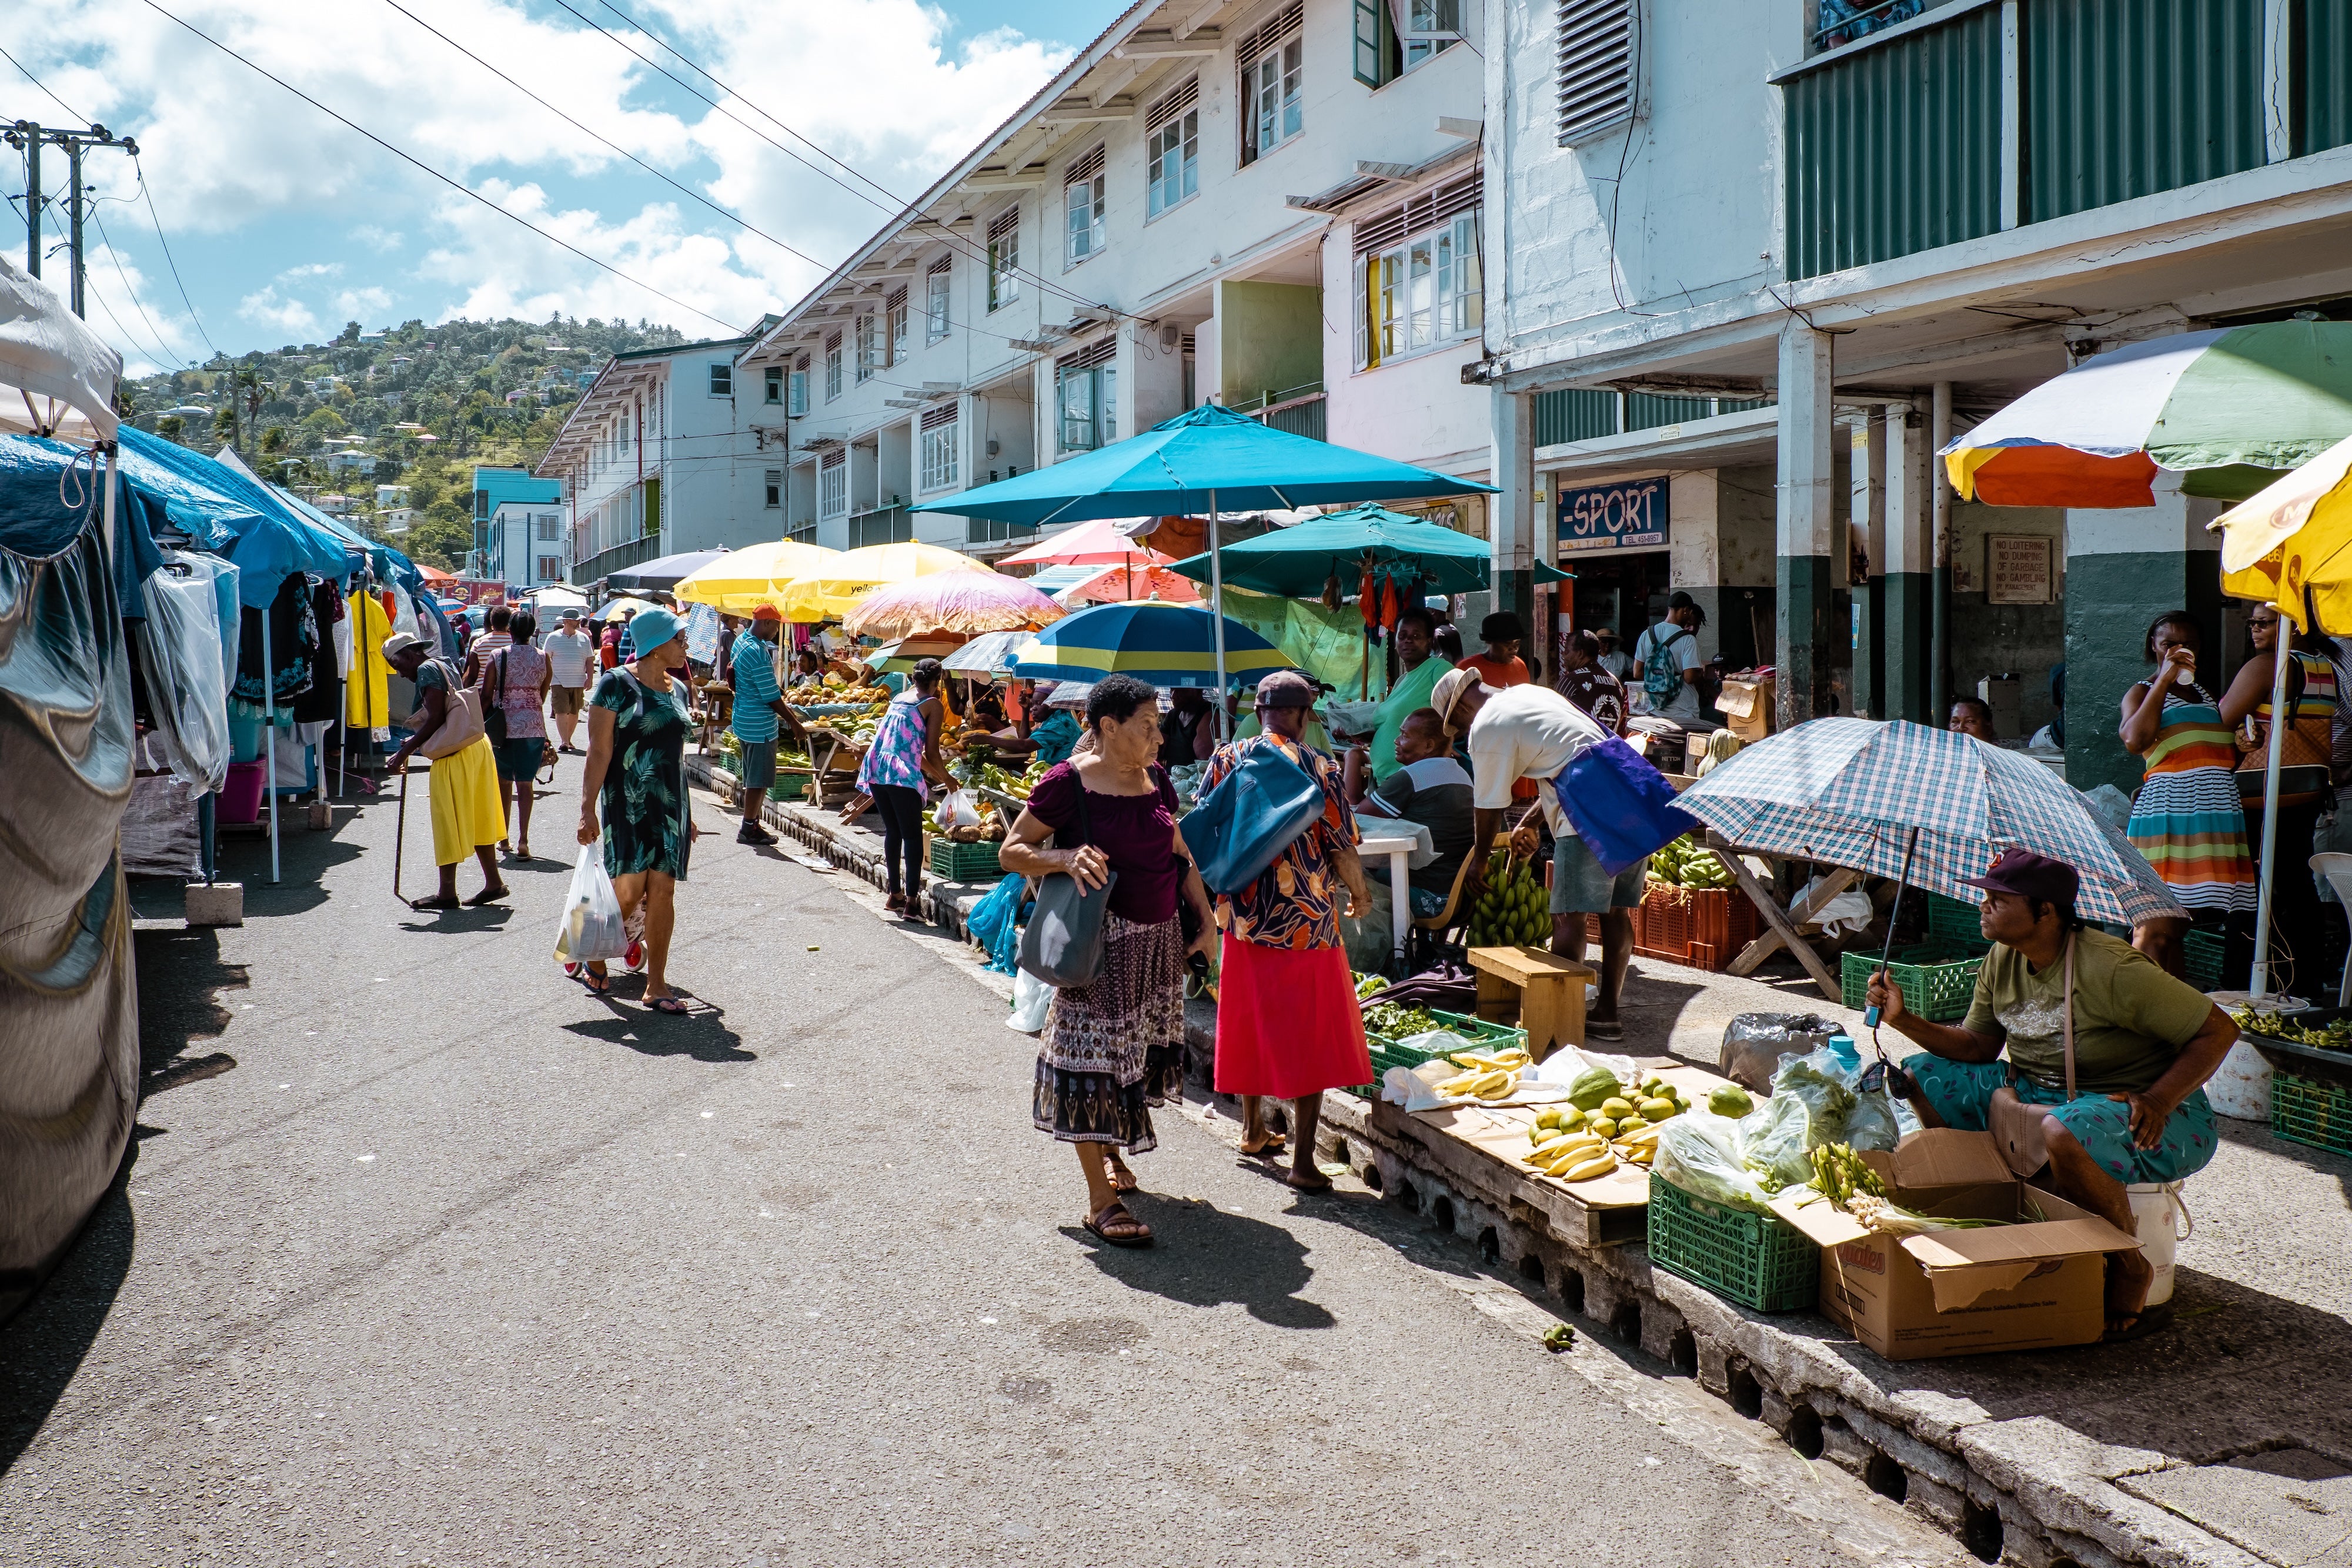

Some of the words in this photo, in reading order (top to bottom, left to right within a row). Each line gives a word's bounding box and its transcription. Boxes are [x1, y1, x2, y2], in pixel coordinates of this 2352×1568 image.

[1638, 534, 1659, 543] 451-8957
[1996, 541, 2006, 549] NO
[2009, 541, 2044, 550] LOITERING
[1999, 551, 2009, 560] NO
[2012, 551, 2042, 561] DUMPING
[1997, 562, 2006, 571] OF
[2011, 563, 2044, 571] GARBAGE
[1996, 573, 2006, 581] NO
[2010, 573, 2046, 583] GAMBLING
